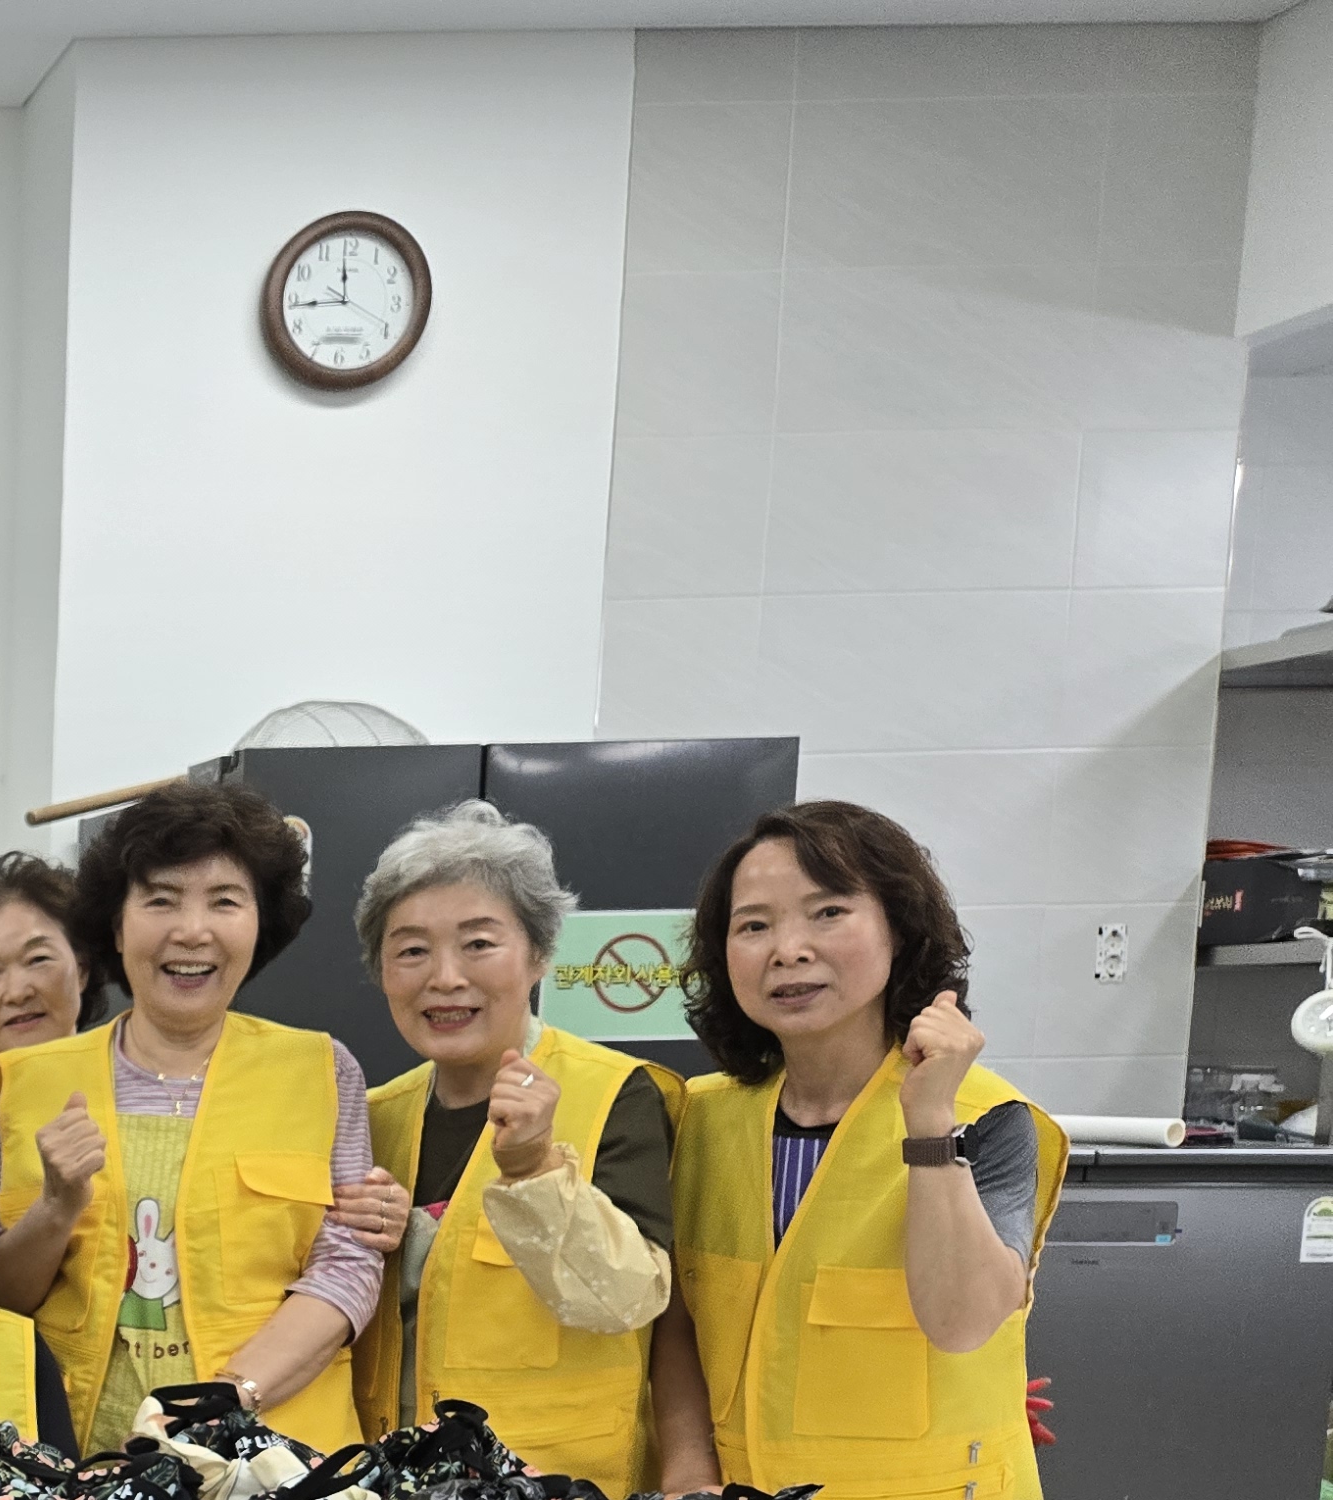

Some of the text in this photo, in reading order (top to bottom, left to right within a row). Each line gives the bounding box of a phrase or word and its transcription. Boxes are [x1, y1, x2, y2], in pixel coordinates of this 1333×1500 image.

[318, 243, 330, 262] 11
[373, 247, 380, 265] 1
[296, 263, 312, 282] 10
[386, 265, 397, 284] 2
[389, 294, 402, 313] 3
[292, 317, 303, 335] 8
[333, 347, 345, 366] 6
